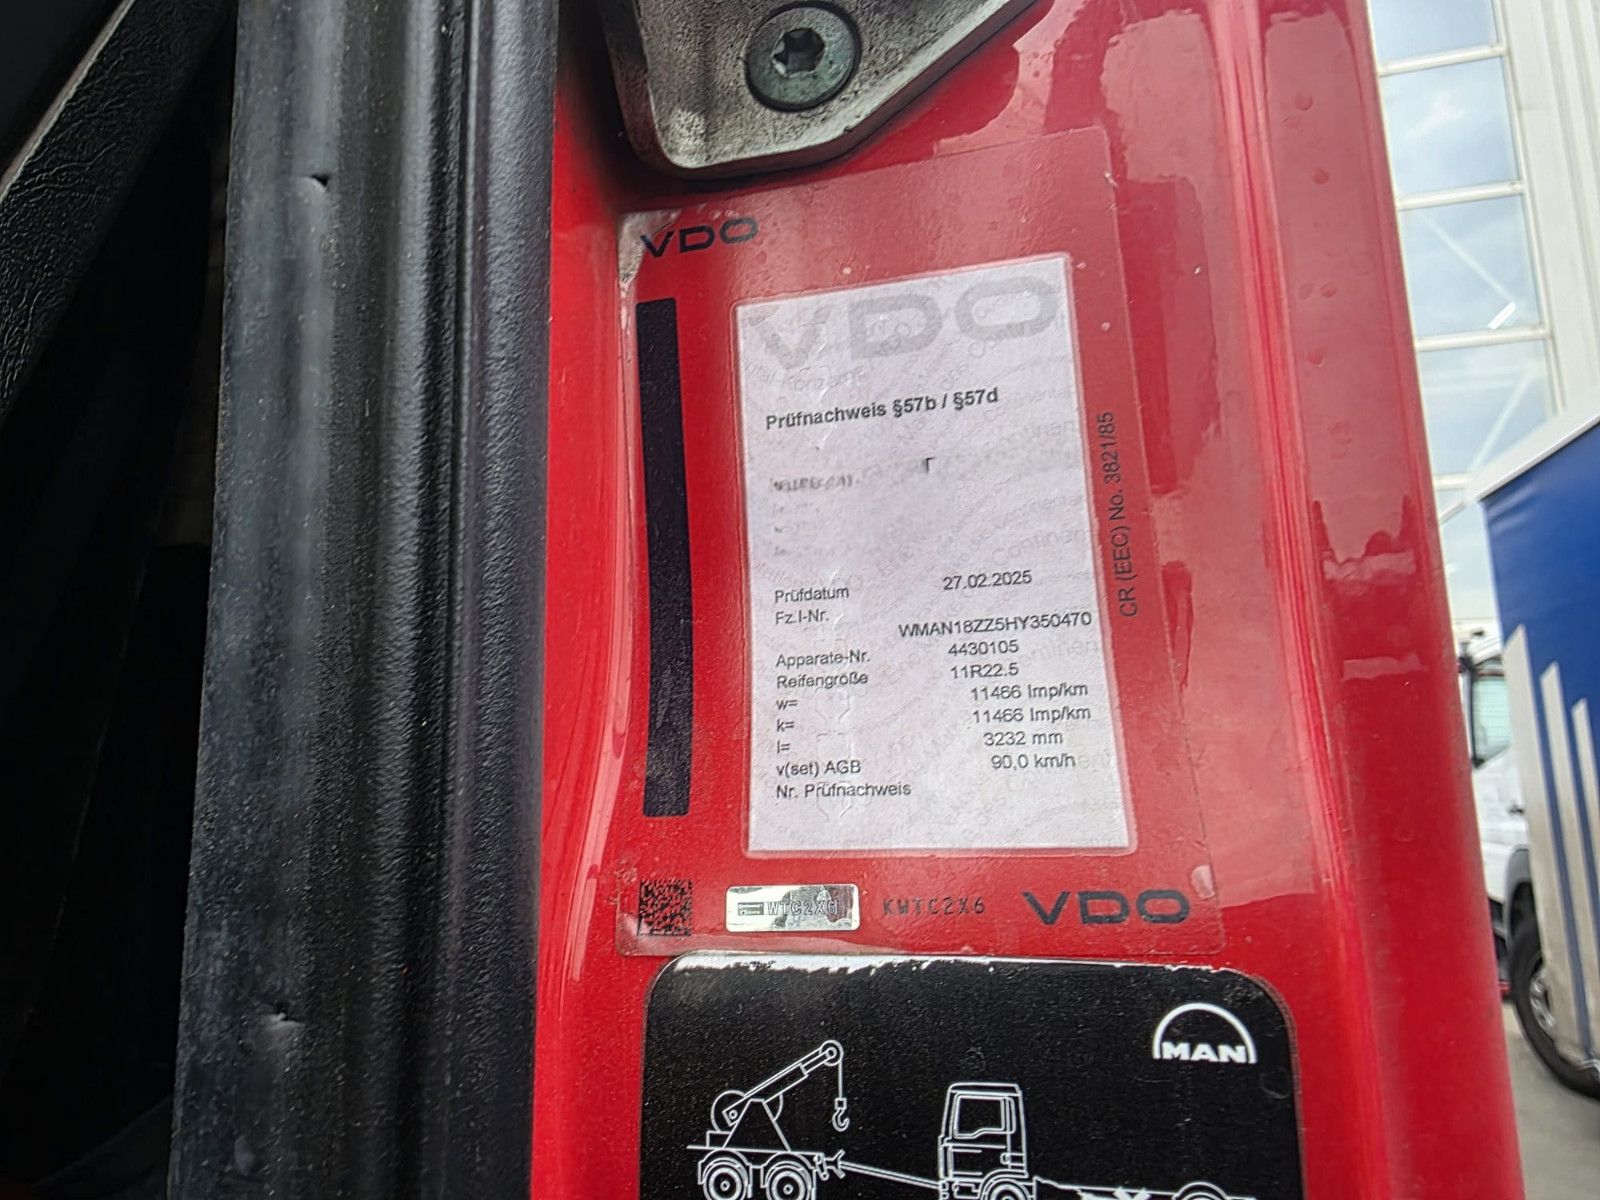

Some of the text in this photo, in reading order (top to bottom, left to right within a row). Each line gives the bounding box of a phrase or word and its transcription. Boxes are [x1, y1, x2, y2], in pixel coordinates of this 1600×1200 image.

[640, 216, 759, 258] VDO
[750, 276, 1059, 370] VDO
[766, 387, 999, 430] Prüfnachweis §57b / §57d
[1097, 411, 1138, 617] CR (EEC) No. 3821/85
[942, 570, 1033, 591] 27.02.2025
[774, 586, 850, 603] Prüfdatum
[898, 611, 1092, 638] WMAN18ZZ5HY350470
[948, 639, 1020, 657] 4430105
[775, 649, 871, 670] Apparate-Nr.
[776, 671, 869, 690] Reifengröße
[951, 662, 1020, 680] 11R22.5
[970, 682, 1089, 701] 11466 Imp/km
[776, 699, 798, 711] w=
[972, 706, 1092, 724] 11466 Imp/km
[776, 718, 795, 732] k=
[983, 731, 1063, 746] 3232 mm
[776, 759, 862, 779] v(set) AGB
[990, 752, 1076, 771] 90,0 km/h
[776, 781, 912, 799] Nr. Prüfnachweis
[766, 900, 839, 916] WTC2X6
[882, 896, 986, 916] KWTC2X6
[1022, 888, 1191, 925] VDO
[1161, 1041, 1248, 1064] MAN
